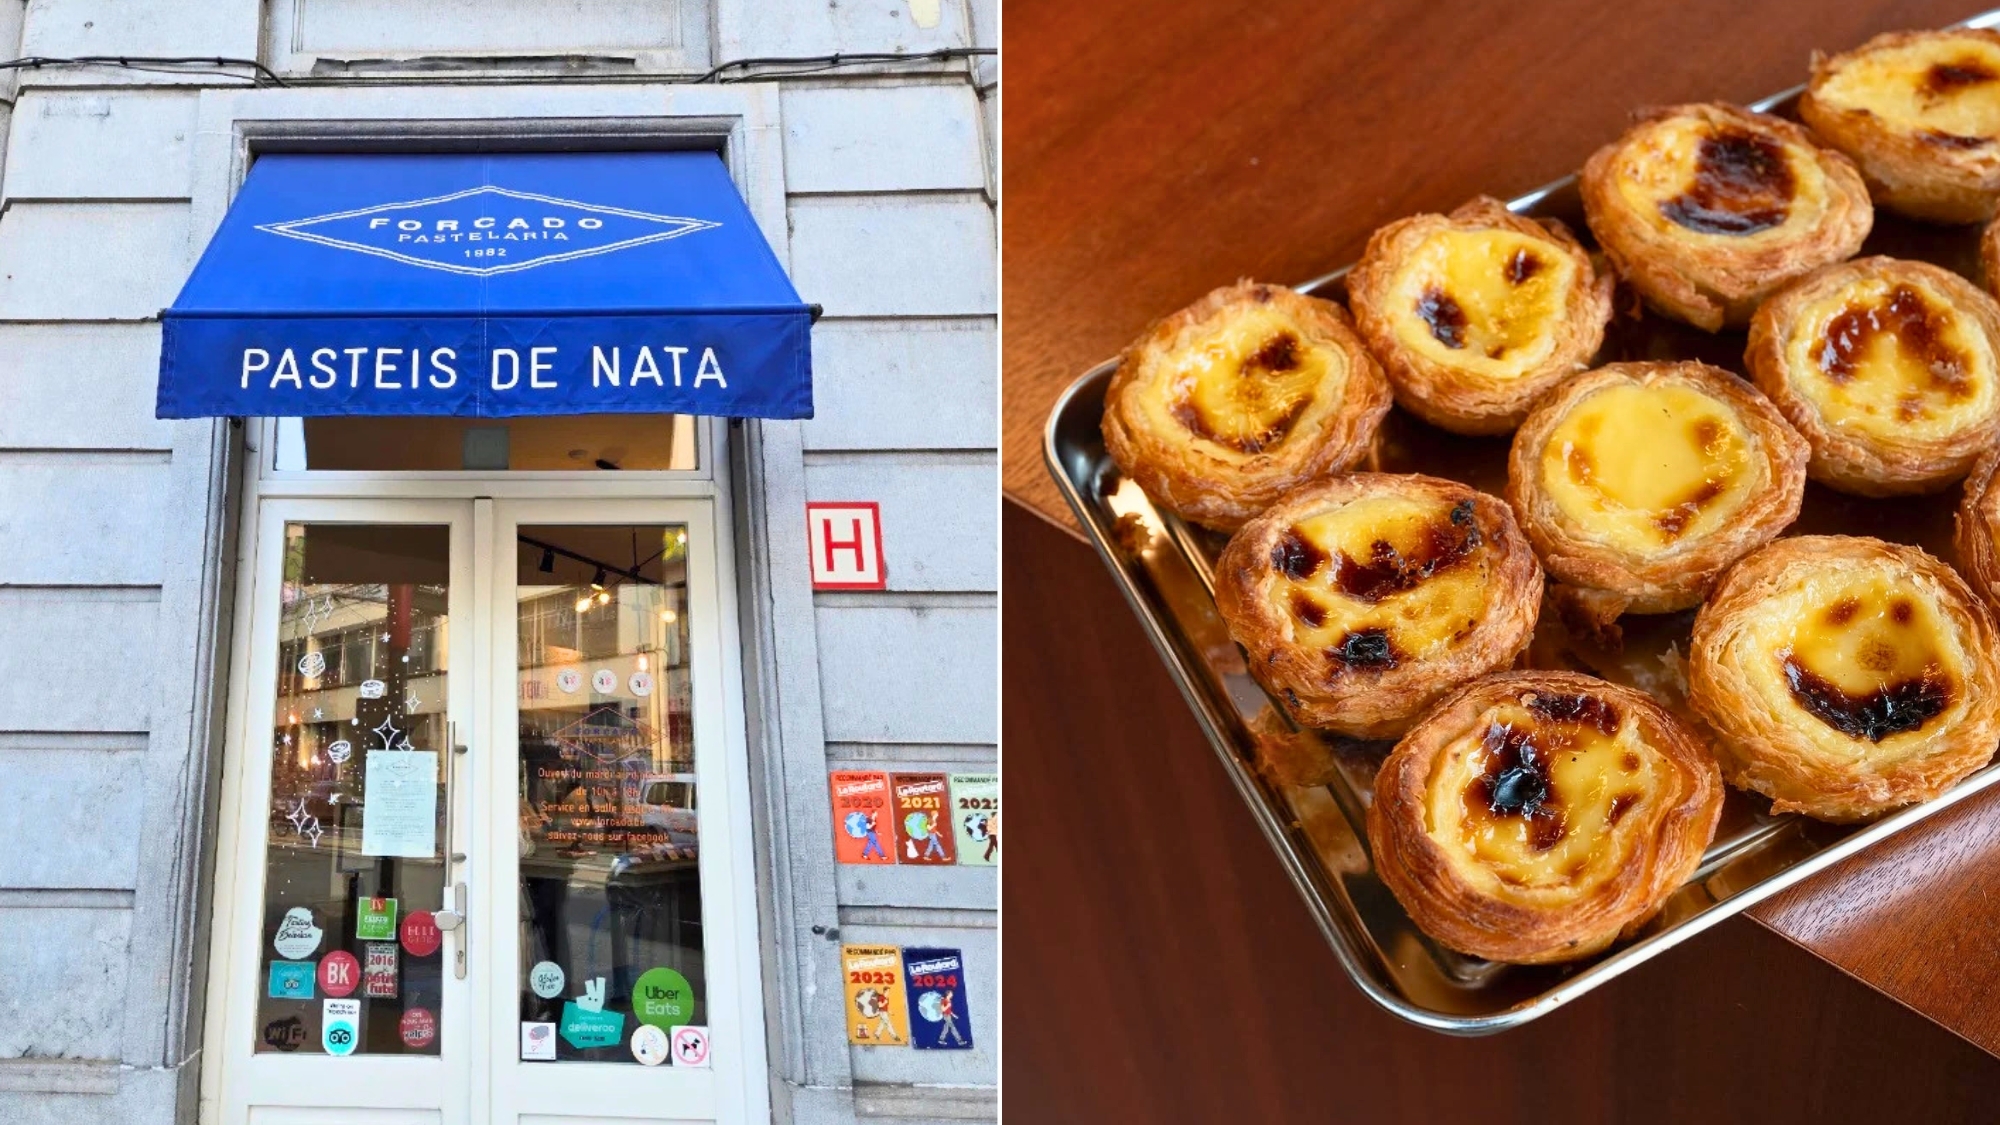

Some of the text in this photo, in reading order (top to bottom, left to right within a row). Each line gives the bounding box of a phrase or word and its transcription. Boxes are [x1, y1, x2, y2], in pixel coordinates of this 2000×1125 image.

[369, 216, 604, 231] FORCADO
[398, 230, 570, 243] PASTELARIA
[464, 247, 507, 258] 1982
[240, 346, 728, 390] PASTEIS DE NATA
[822, 518, 865, 572] H
[901, 797, 941, 809] 2021
[369, 954, 394, 966] 2016
[327, 962, 350, 984] BK
[850, 971, 895, 984] 2023
[913, 975, 957, 987] 2024
[645, 986, 679, 1001] Uber
[645, 1001, 681, 1016] Eats
[568, 1022, 616, 1034] deliveroo
